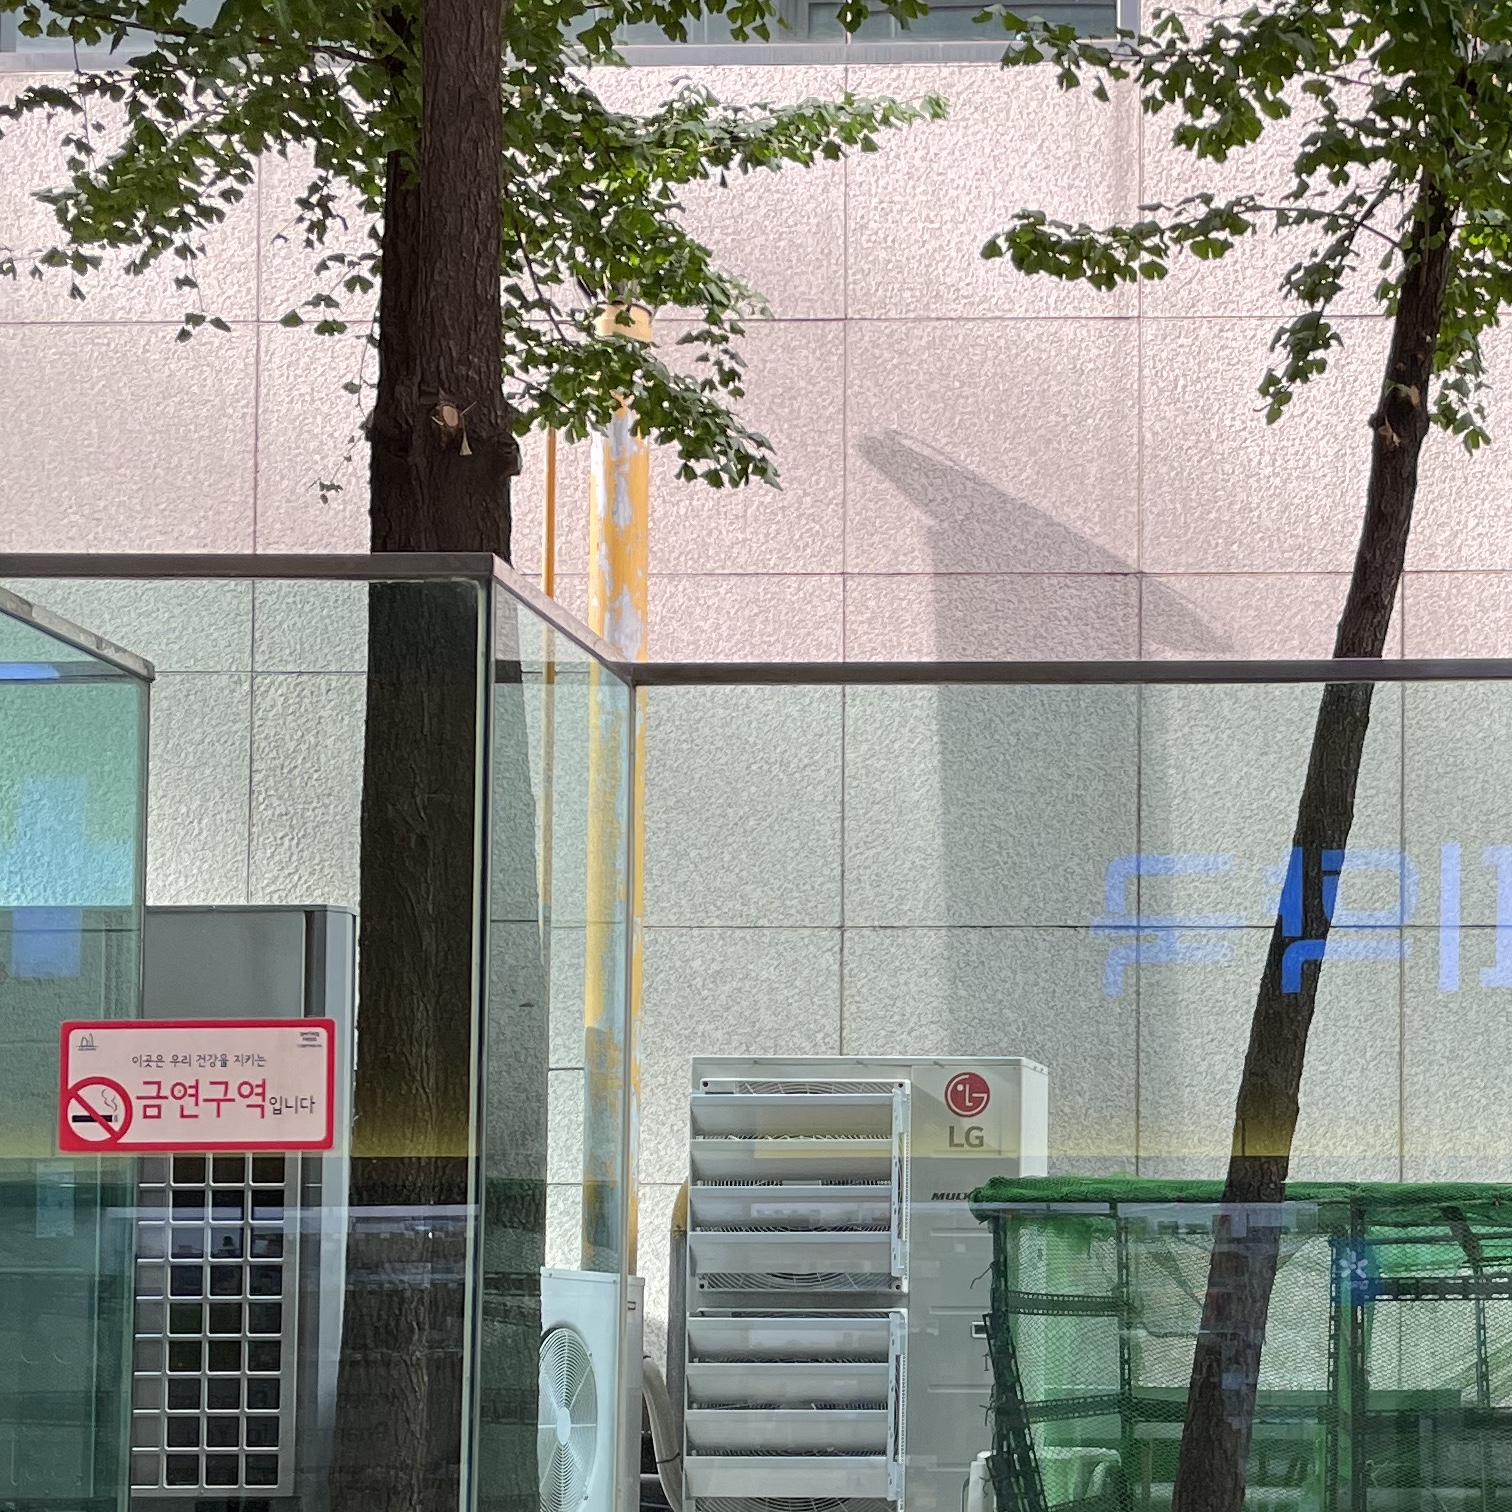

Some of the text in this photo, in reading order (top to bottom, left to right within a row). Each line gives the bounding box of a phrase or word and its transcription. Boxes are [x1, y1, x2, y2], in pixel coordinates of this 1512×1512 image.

[131, 1053, 267, 1068] 이곳은 우리 건강을 지키는
[948, 1125, 985, 1148] LG
